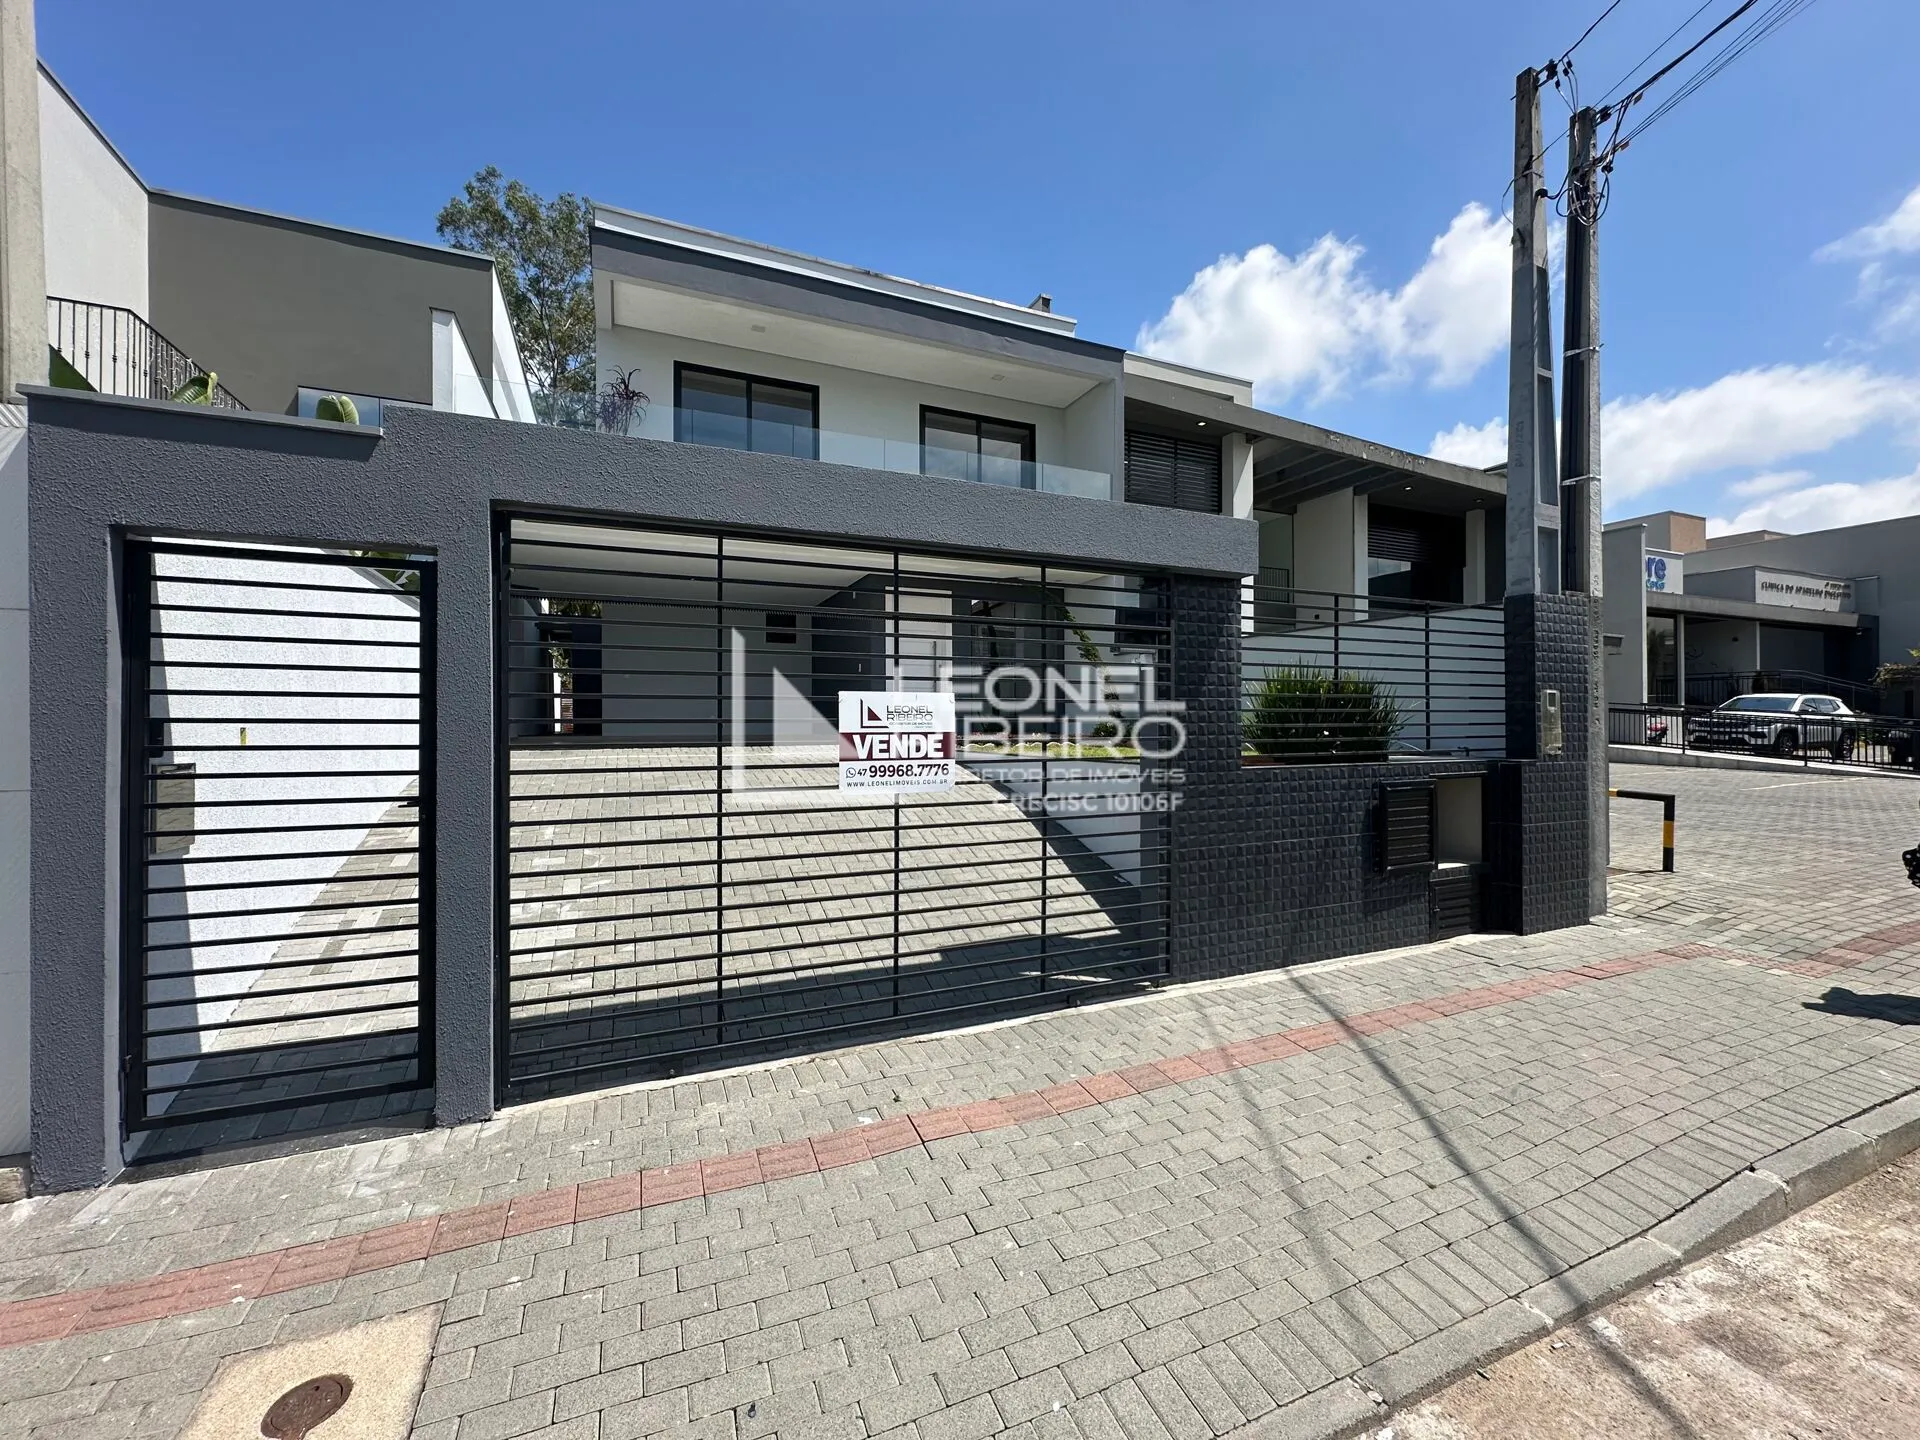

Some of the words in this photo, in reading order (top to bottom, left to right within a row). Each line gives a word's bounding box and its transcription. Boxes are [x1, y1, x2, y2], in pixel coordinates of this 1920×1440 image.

[887, 705, 933, 714] LEONEL
[887, 713, 934, 722] RIBEIRO
[853, 734, 943, 758] VENDE
[857, 768, 868, 777] 47
[869, 763, 950, 778] 99968.7776
